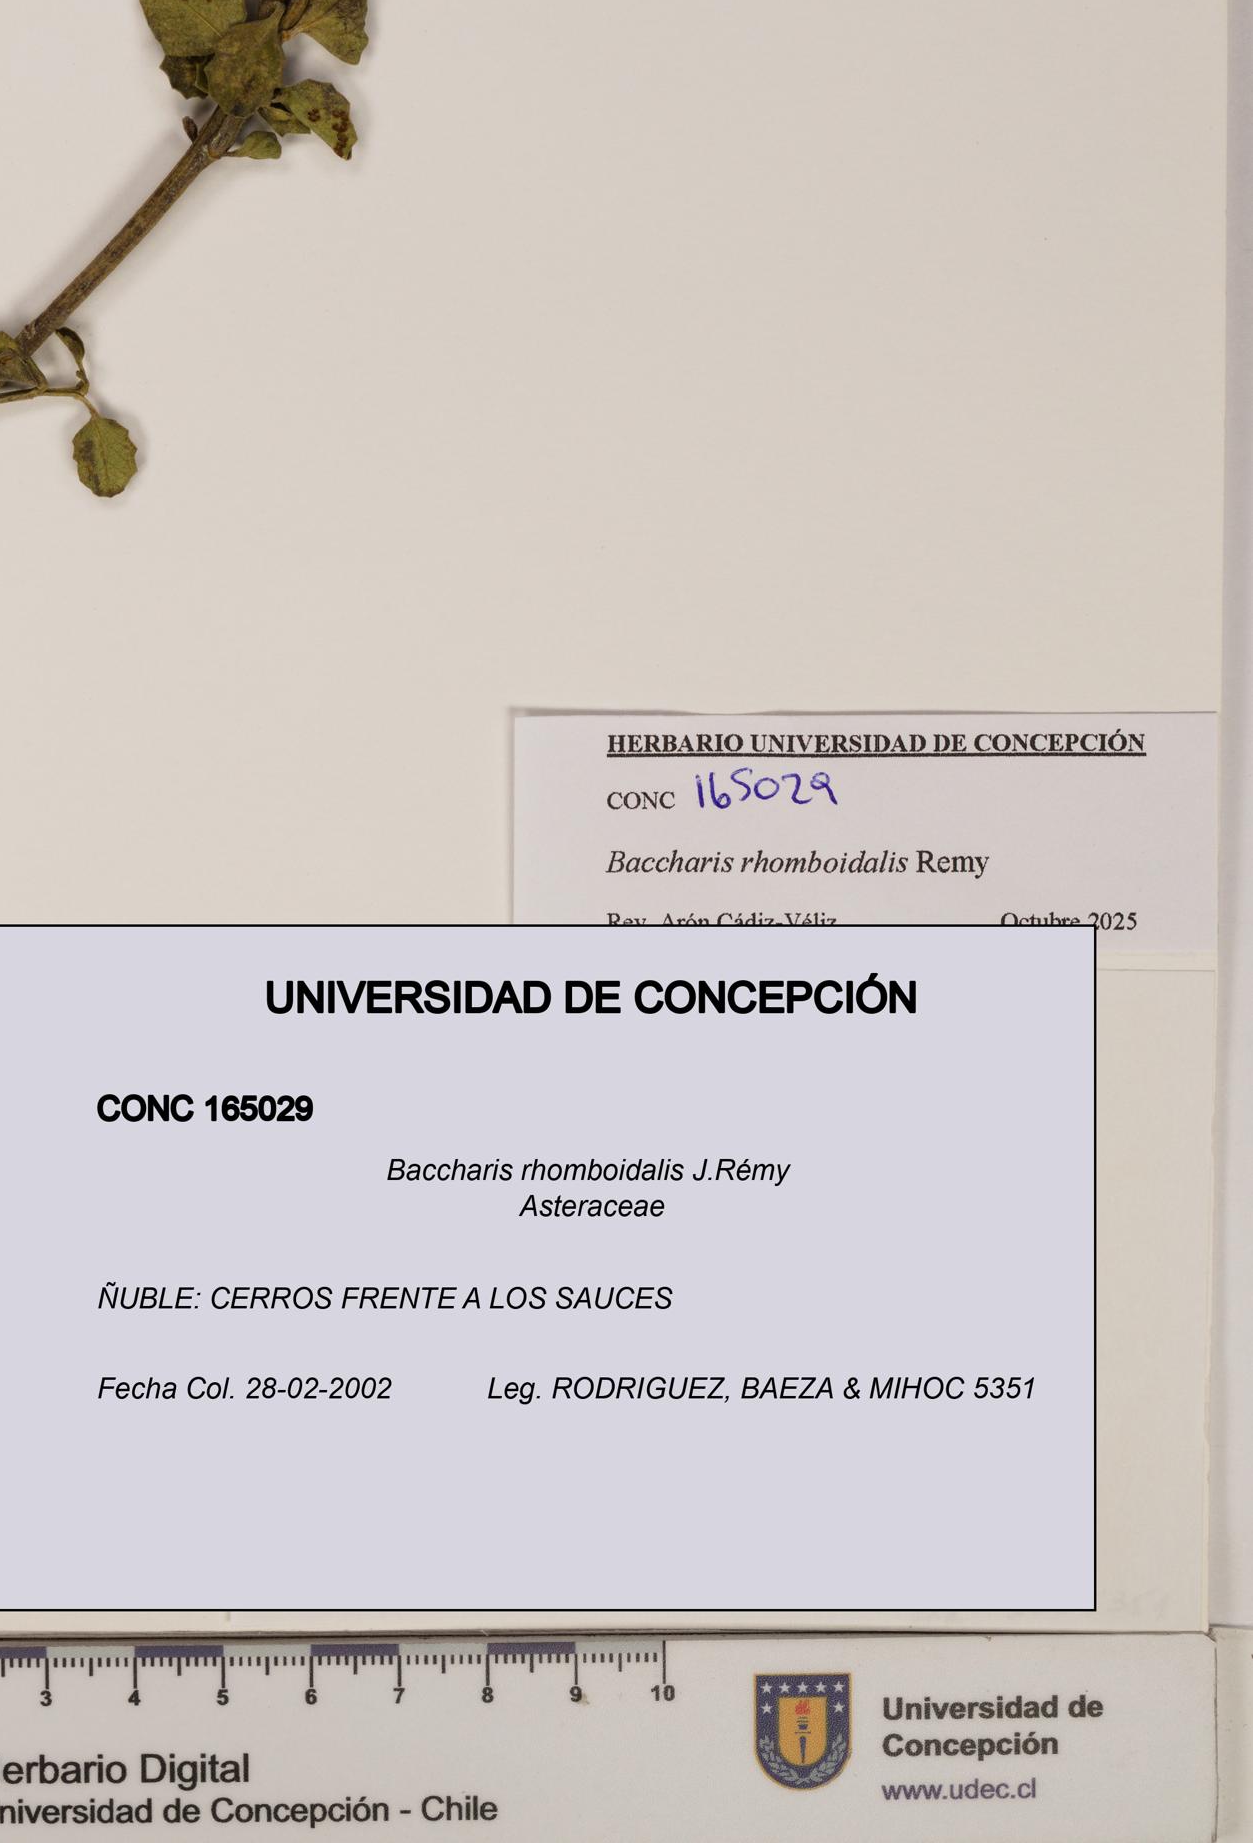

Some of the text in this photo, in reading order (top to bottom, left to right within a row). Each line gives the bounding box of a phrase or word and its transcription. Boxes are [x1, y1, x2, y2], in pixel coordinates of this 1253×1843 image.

[607, 728, 1146, 756] HERBARIO UNIVERSIDAD DE CONCEPCIÓN
[606, 790, 676, 811] CONC
[695, 767, 838, 810] 165029
[605, 849, 990, 880] Baccharis rhomboidalis Remy
[1087, 911, 1138, 931] 2025
[39, 1689, 53, 1707] 3
[127, 1689, 142, 1706] 4
[216, 1688, 230, 1706] 5
[304, 1688, 318, 1705] 6
[392, 1687, 406, 1704] 7
[481, 1686, 495, 1704] 8
[569, 1685, 583, 1703] 9
[650, 1684, 676, 1702] 10
[882, 1694, 1104, 1721] Universidad de
[881, 1731, 1059, 1762] Concepción
[140, 1752, 250, 1789] Digital
[880, 1777, 1037, 1801] www.udec.cl
[162, 1797, 201, 1824] de
[210, 1795, 390, 1829] Concepción
[421, 1795, 499, 1822] Chile
